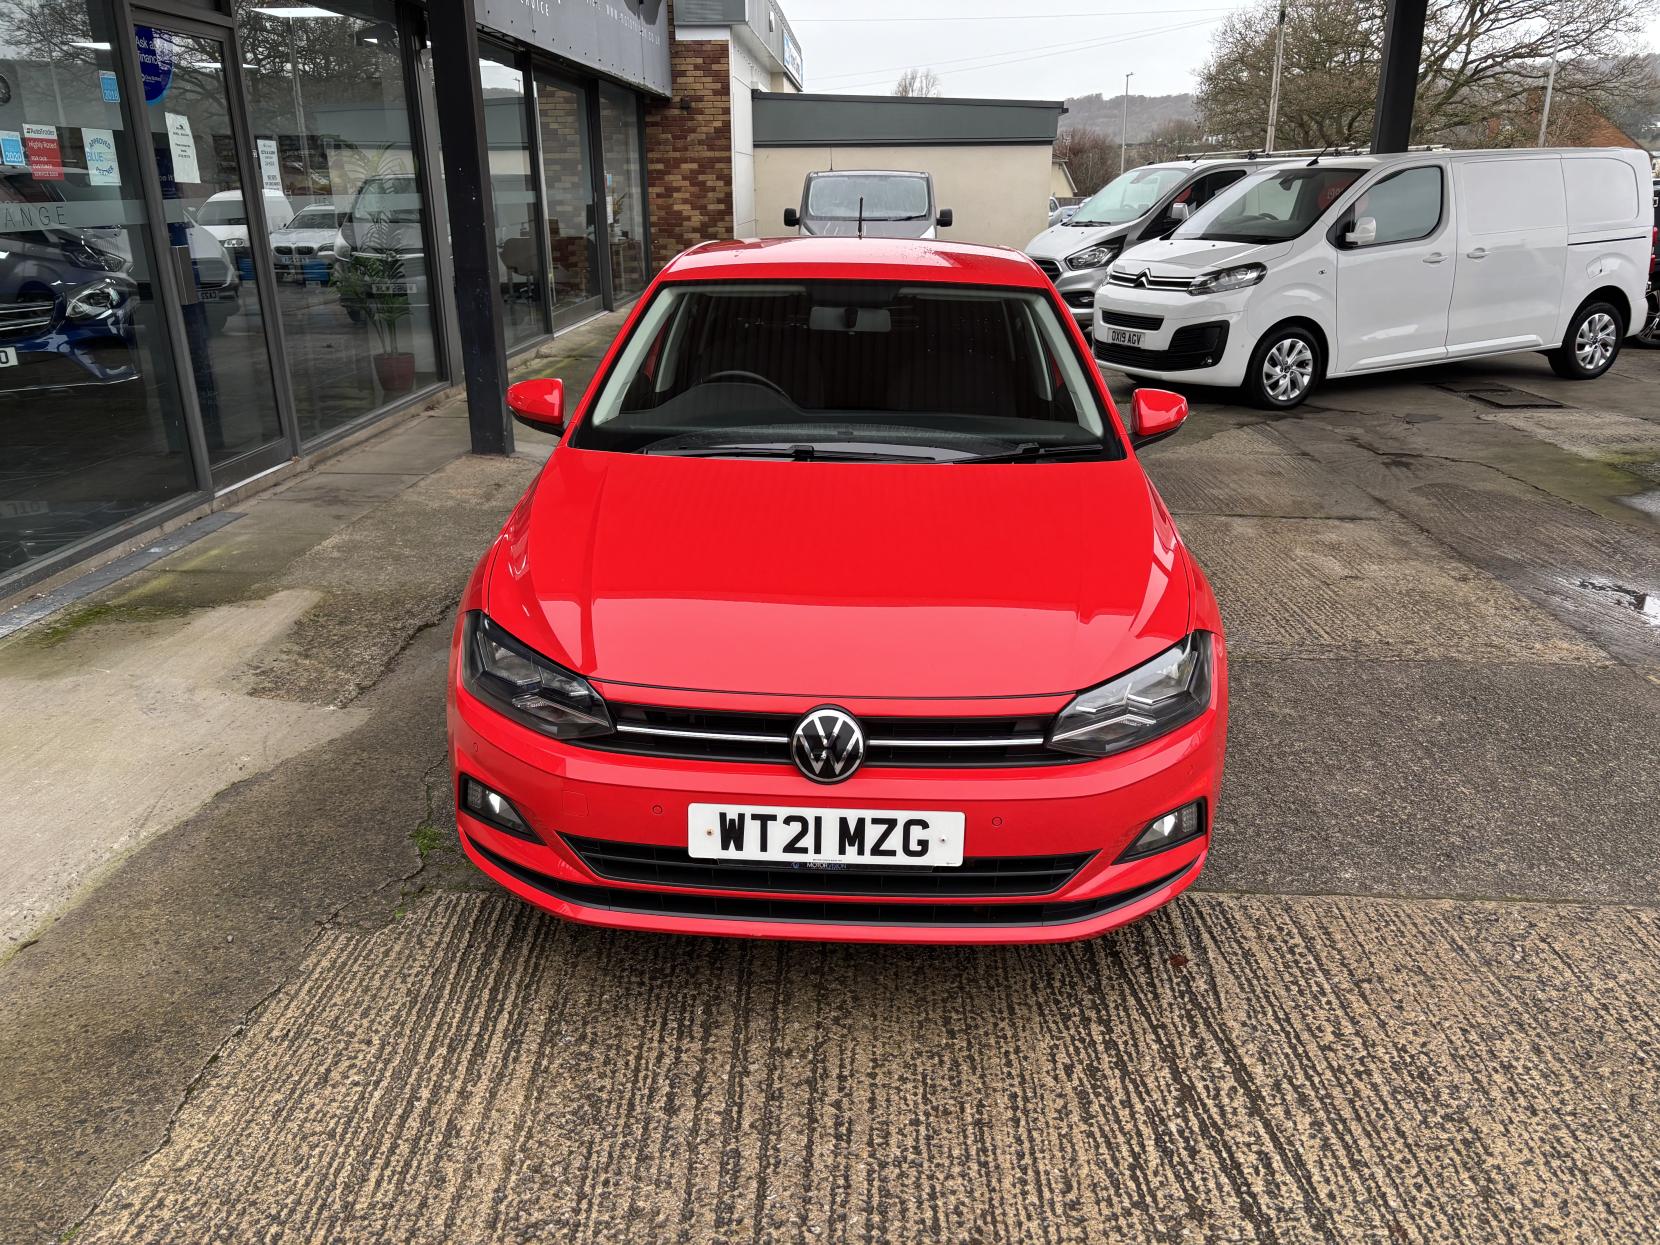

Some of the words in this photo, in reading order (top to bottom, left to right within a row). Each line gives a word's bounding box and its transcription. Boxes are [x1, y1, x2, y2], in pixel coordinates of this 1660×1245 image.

[6, 152, 22, 161] 2020
[1112, 331, 1126, 343] OX19
[1127, 333, 1142, 345] AGV
[718, 811, 823, 854] WT21
[838, 816, 930, 858] MZG
